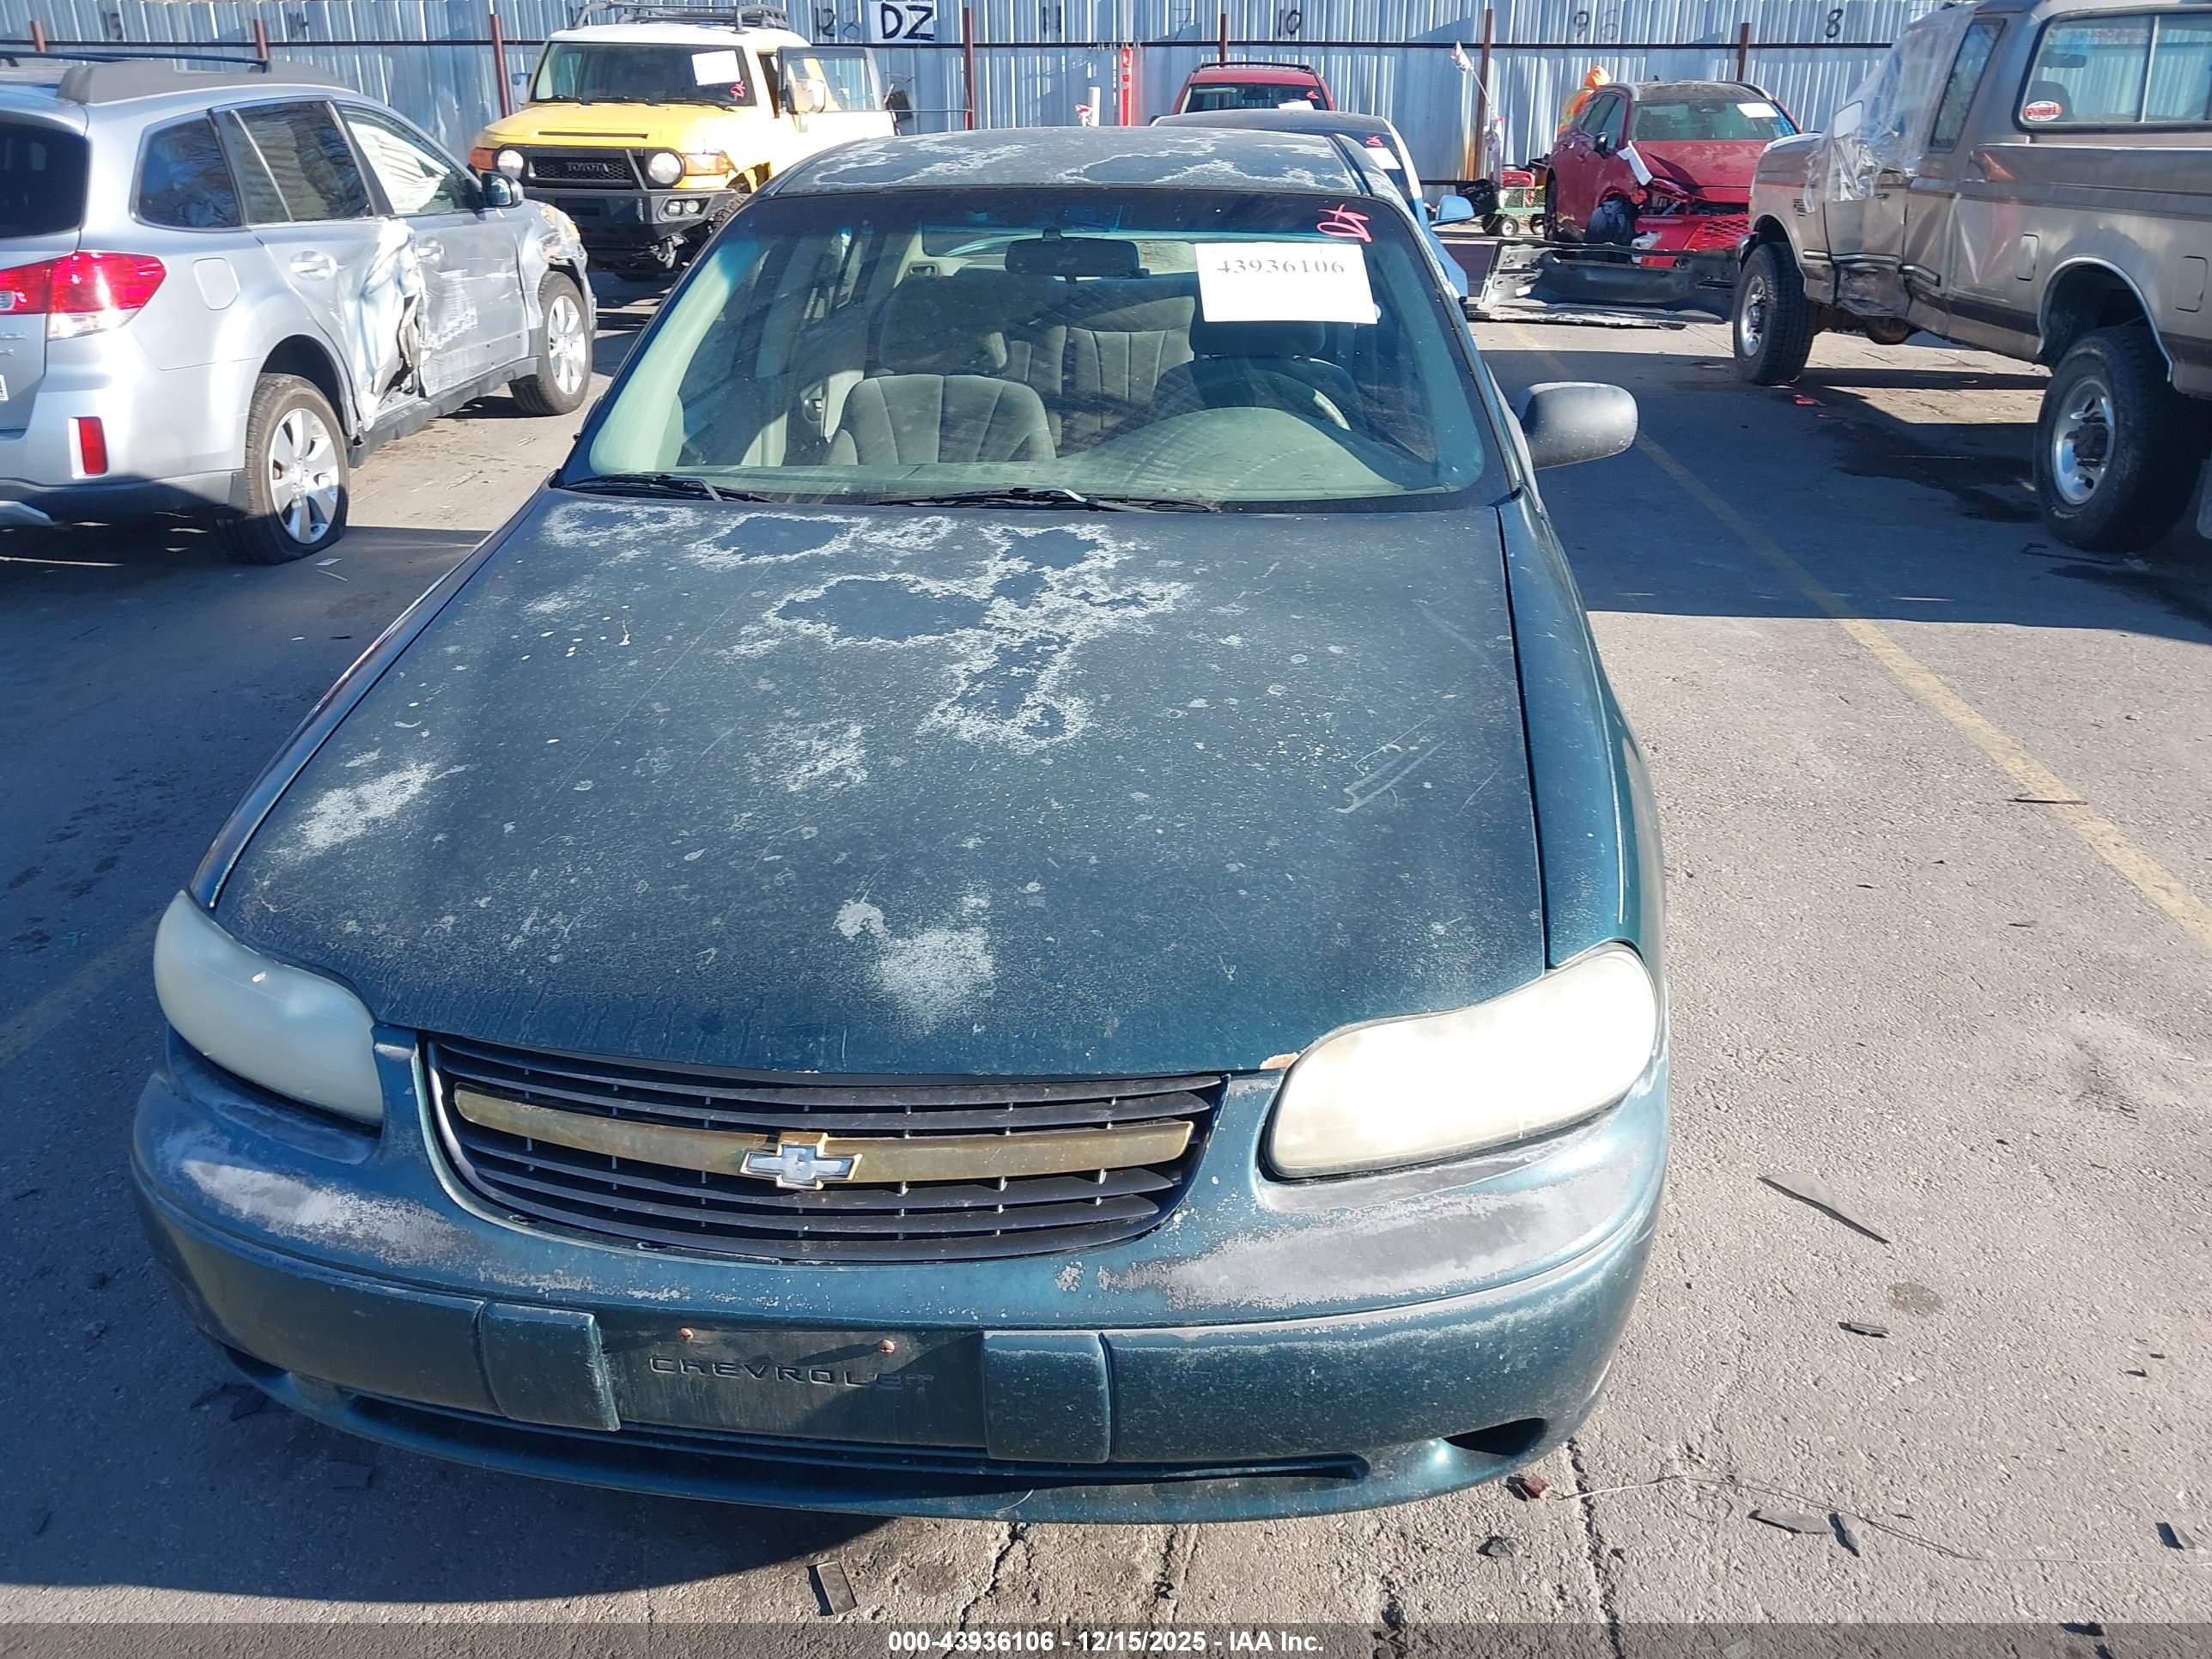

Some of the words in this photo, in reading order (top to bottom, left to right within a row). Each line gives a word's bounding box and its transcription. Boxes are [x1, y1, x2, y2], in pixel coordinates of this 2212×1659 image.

[880, 3, 934, 40] DZ
[1278, 9, 1301, 38] 10
[1825, 9, 1844, 39] 8
[565, 161, 610, 173] TOYOTA
[1216, 259, 1345, 275] 43936106
[649, 1356, 935, 1390] CHEVROLET
